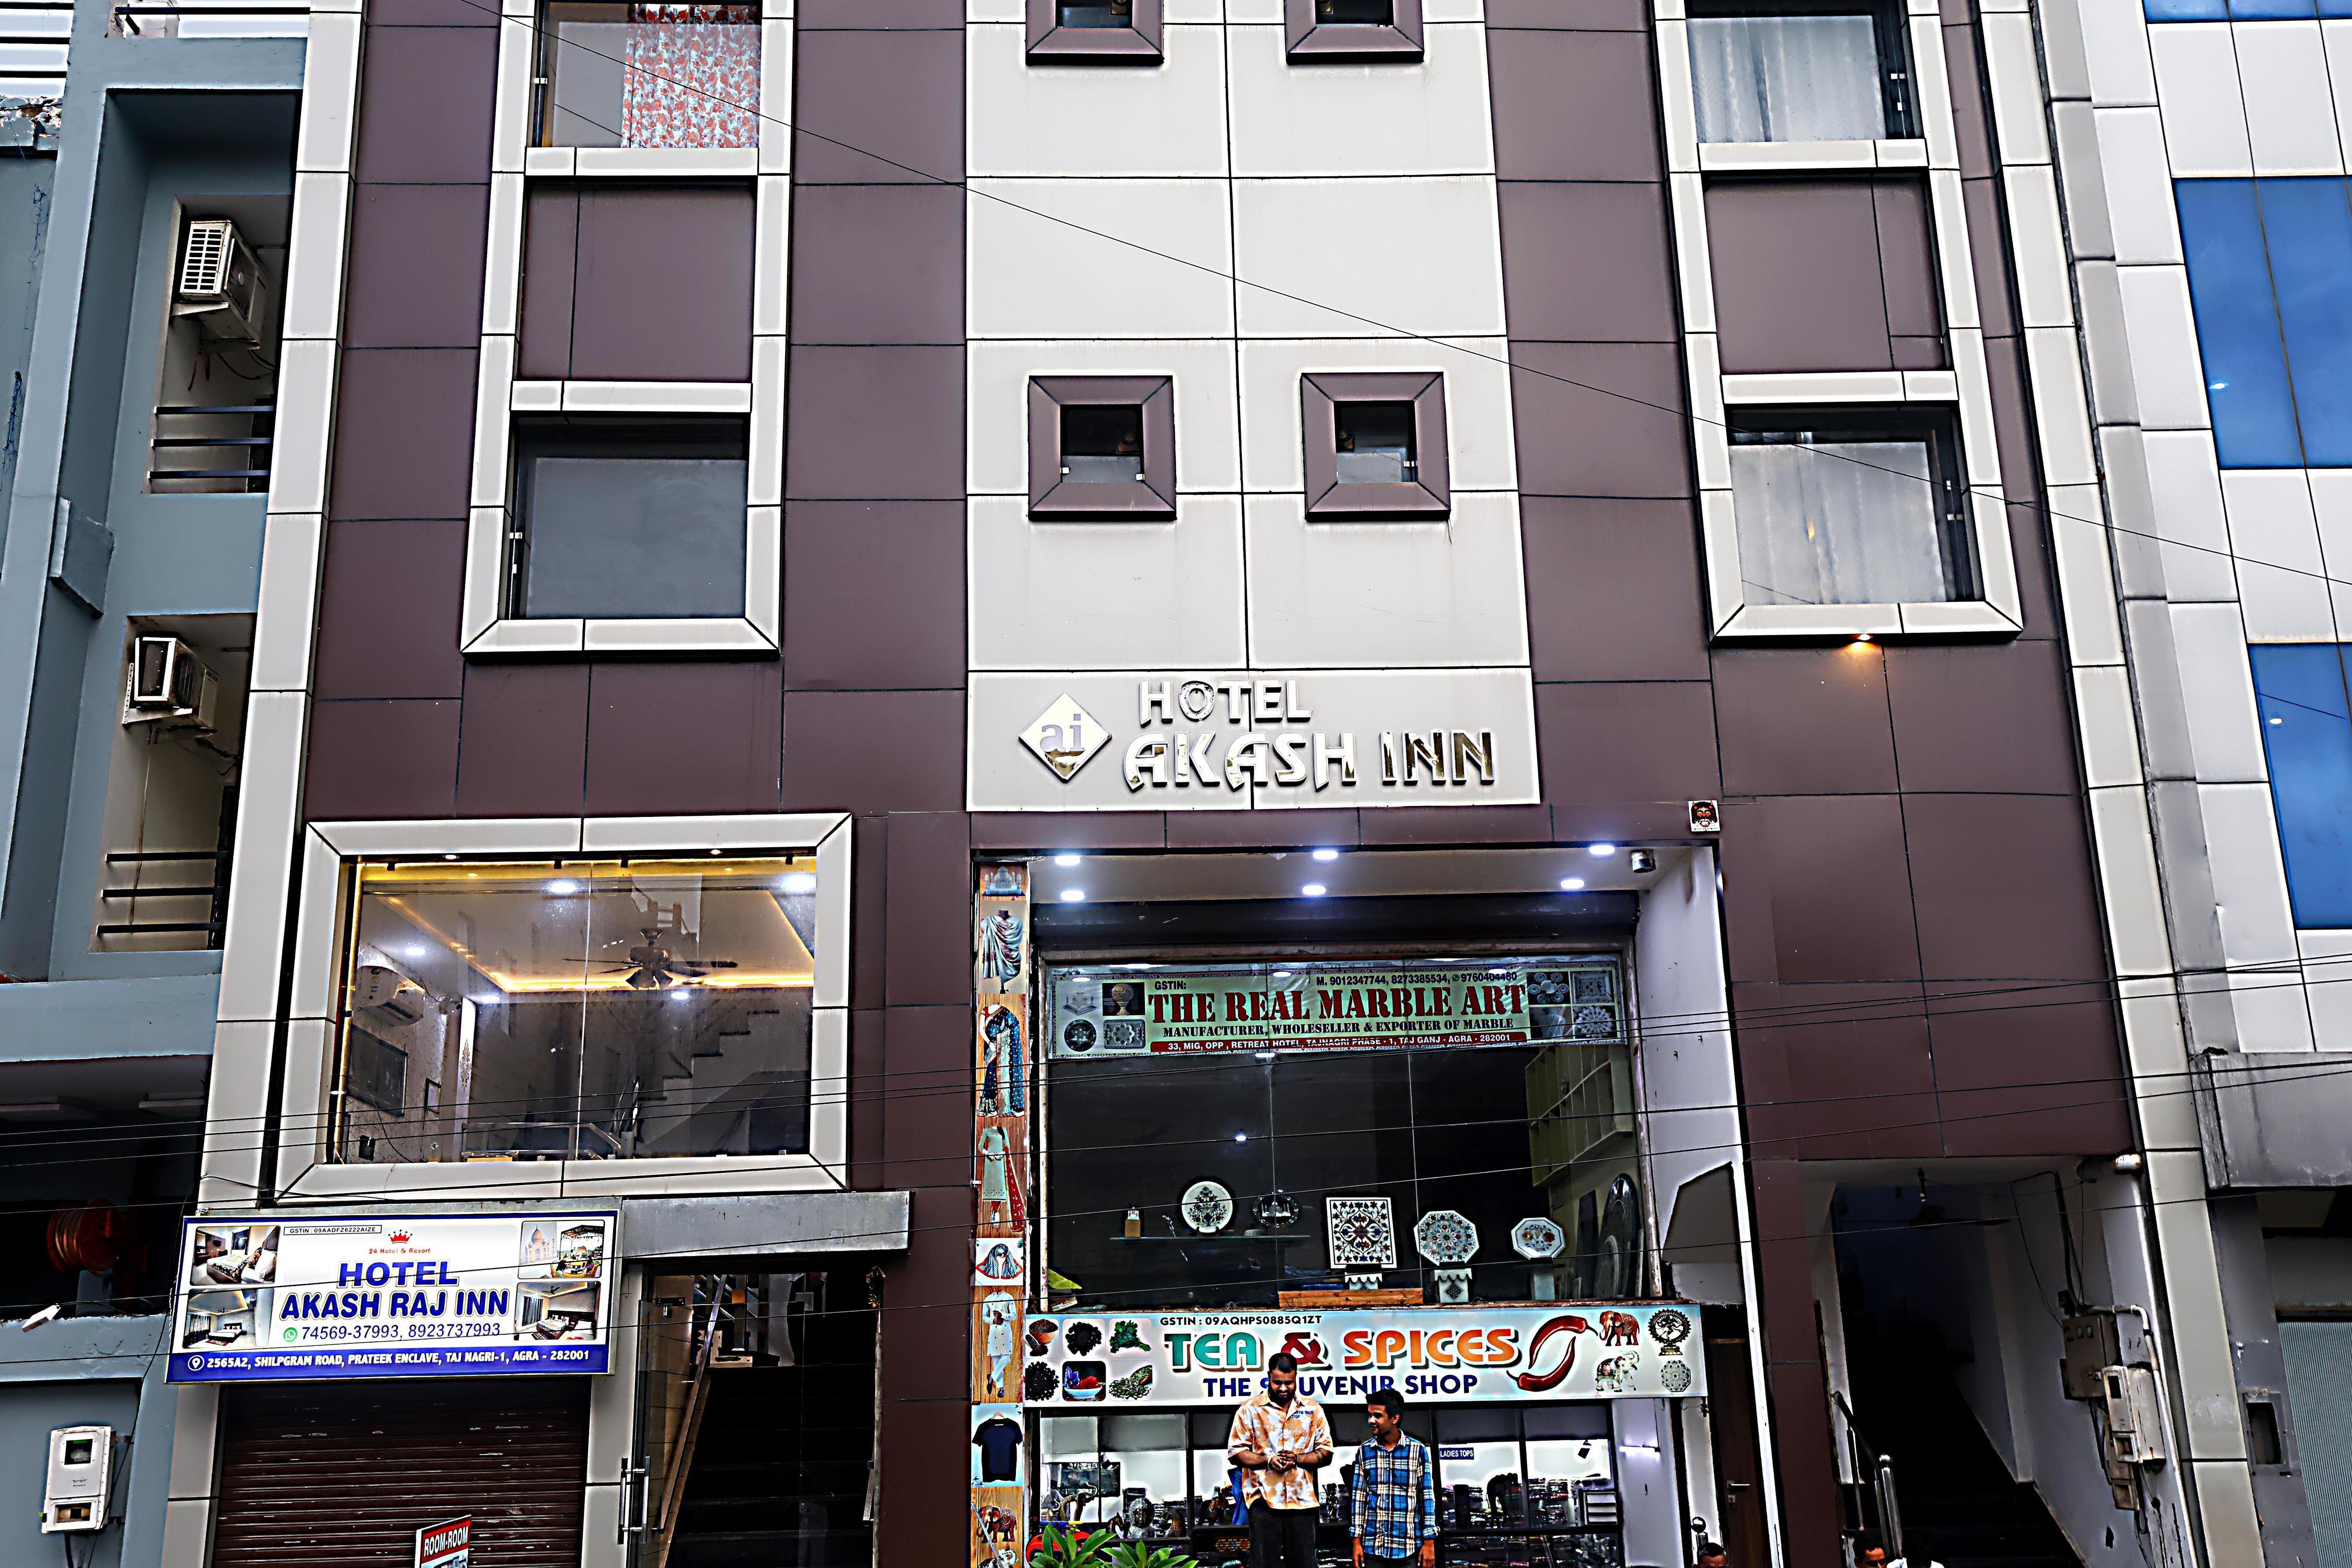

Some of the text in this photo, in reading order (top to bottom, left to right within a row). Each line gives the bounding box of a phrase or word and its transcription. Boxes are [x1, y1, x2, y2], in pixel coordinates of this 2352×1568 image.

[1139, 678, 1312, 727] HOTEL
[1123, 729, 1495, 792] AKASH INN
[1155, 972, 1517, 990] GSTIN: M. 9012347744, 8273385534, 9760404480
[1149, 984, 1526, 1023] THE REAL MARBLE ART
[1163, 1018, 1514, 1037] MANUFACTURER, WHOLESELLER & EXPORTER OF MARBLE
[1184, 1042, 1203, 1051] MIG,
[1273, 1040, 1304, 1048] HOTEL,
[1480, 1034, 1510, 1042] 282001
[338, 1260, 458, 1287] HOTEL
[281, 1289, 509, 1319] AKASH RAJ INN
[302, 1323, 500, 1341] 74569-37993, 8923737993
[1160, 1316, 1196, 1325] GSTIN
[1205, 1315, 1322, 1325] 09AQHPS0885Q1ZT
[207, 1357, 251, 1370] 2565A2,
[255, 1355, 313, 1367] SHILPGRAM
[315, 1354, 345, 1368] ROAD,
[348, 1353, 393, 1365] PRATEEK
[395, 1352, 442, 1365] ENCLAVE,
[445, 1352, 462, 1363] TAJ
[465, 1351, 510, 1364] NAGRI-1,
[513, 1350, 539, 1361] AGRA
[550, 1350, 589, 1361] 282001
[1164, 1329, 1520, 1371] TEA & SPICES
[1203, 1374, 1479, 1398] THE UVENIR SHOP
[424, 1526, 468, 1557] ROOM-ROOM
